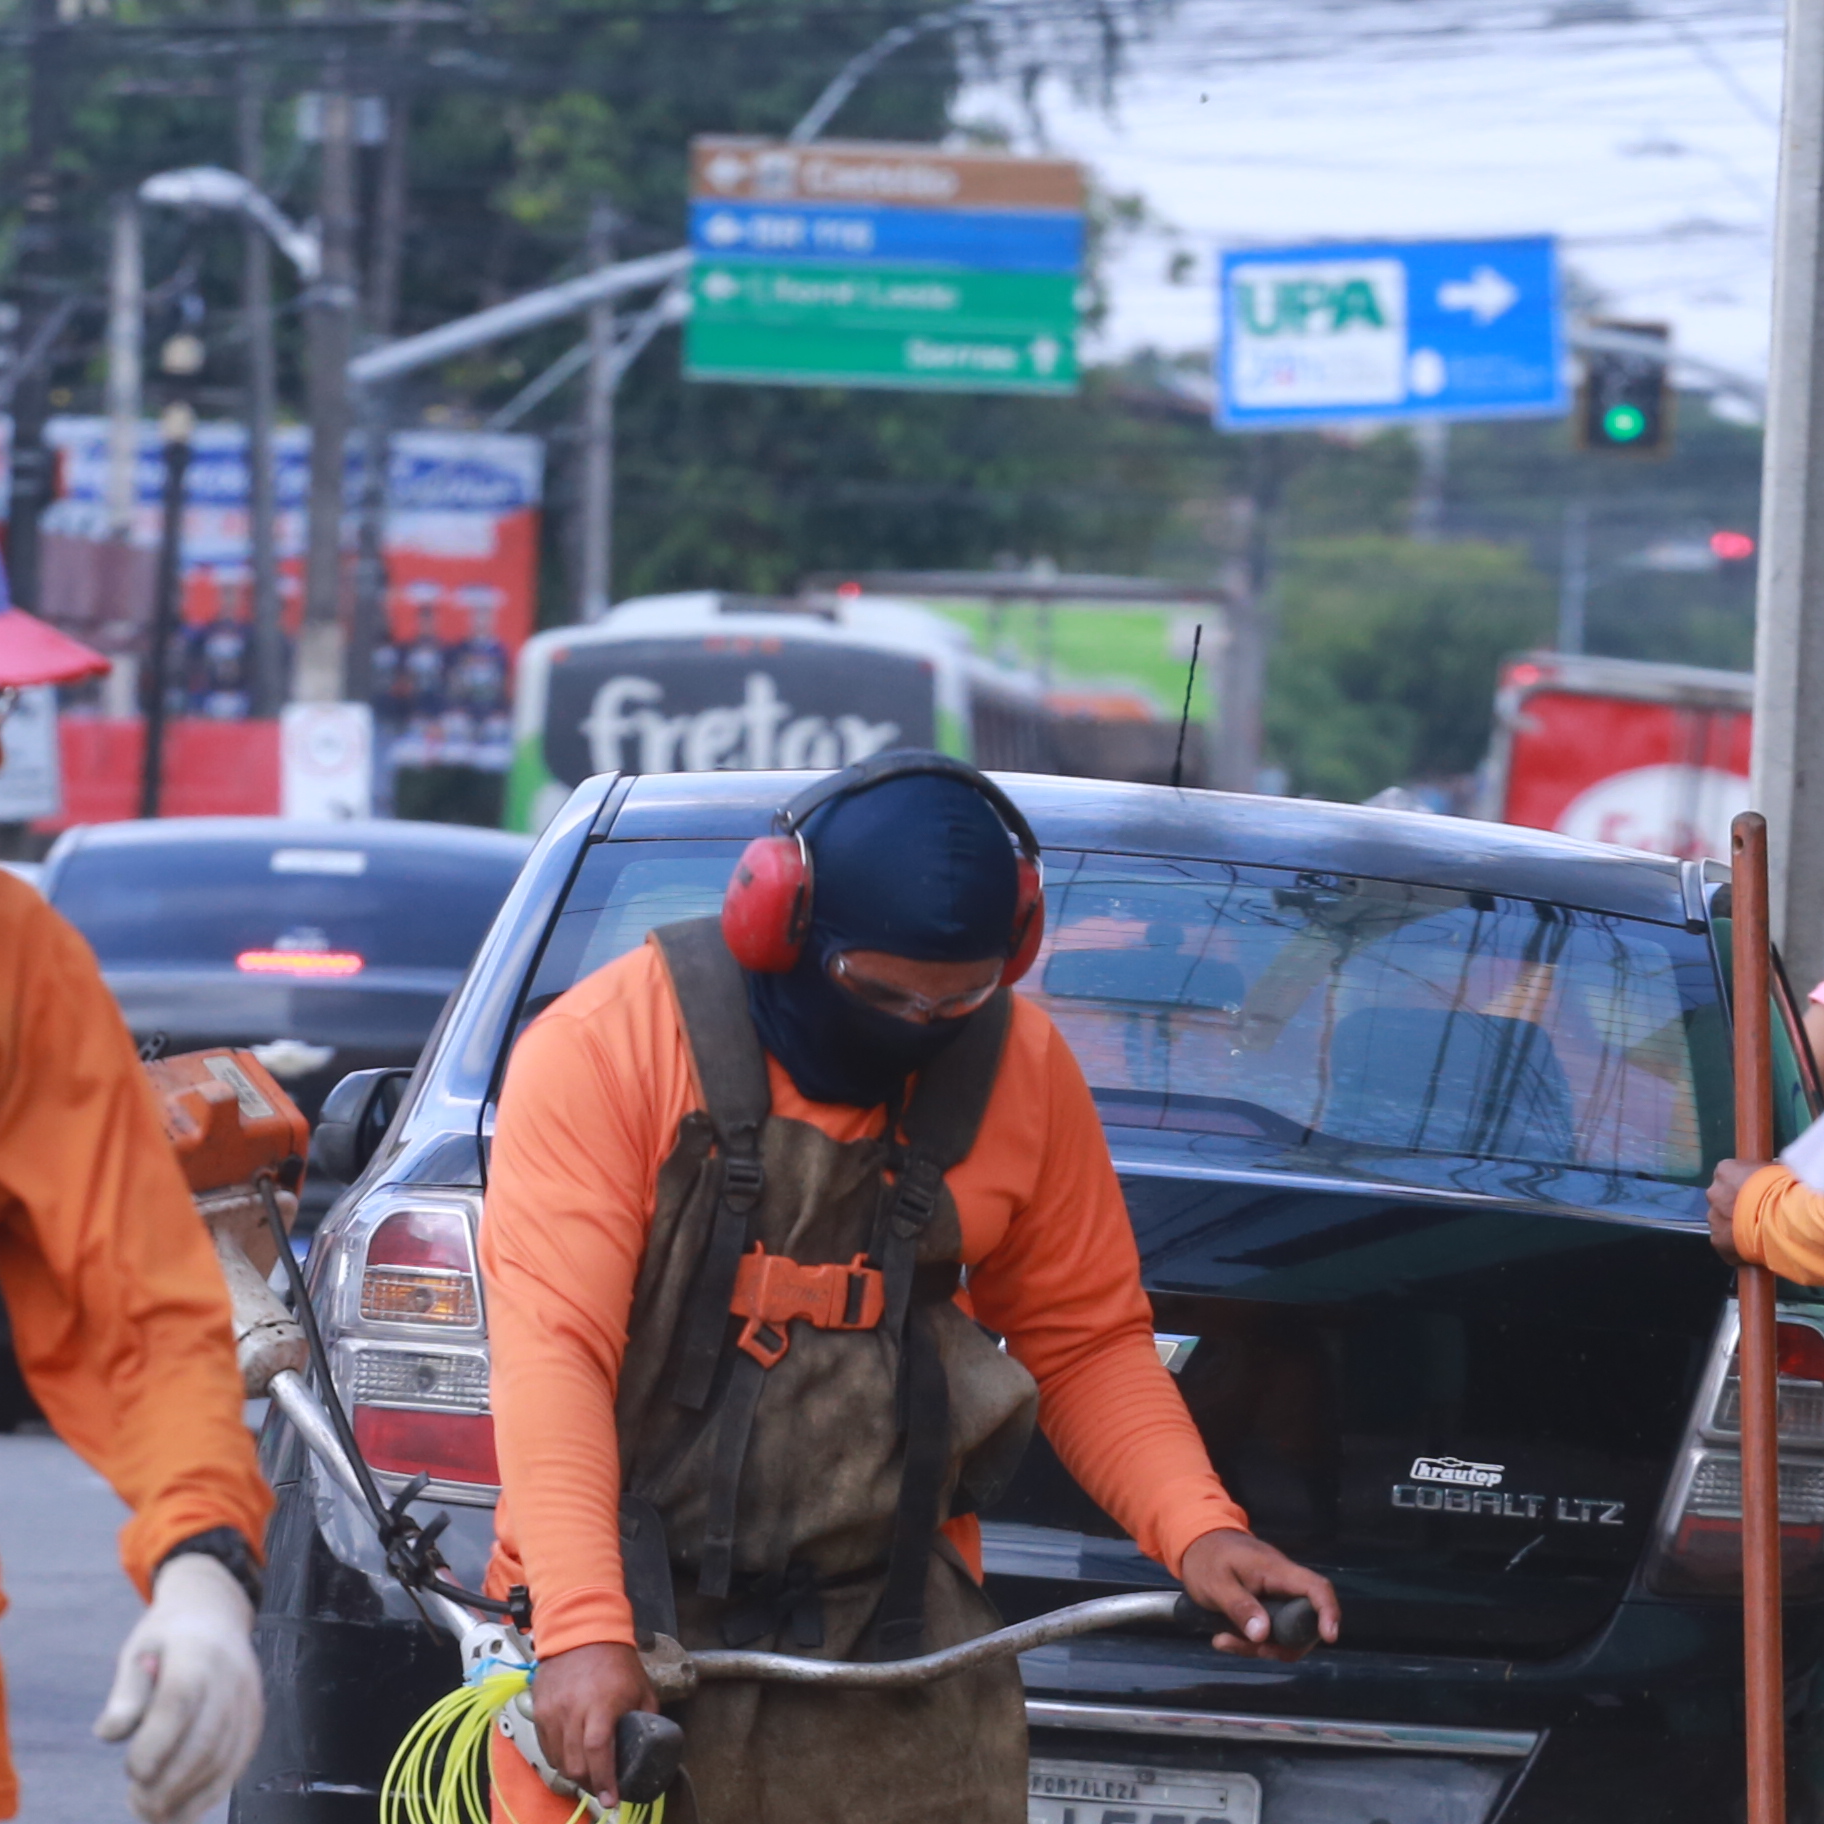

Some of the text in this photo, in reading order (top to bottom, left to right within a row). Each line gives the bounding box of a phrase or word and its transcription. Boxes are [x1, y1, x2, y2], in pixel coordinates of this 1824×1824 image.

[1234, 278, 1386, 338] UPA
[1417, 1462, 1503, 1487] krautop
[1391, 1484, 1625, 1525] COBALT LTZ
[1031, 1774, 1139, 1800] FORTALEZA
